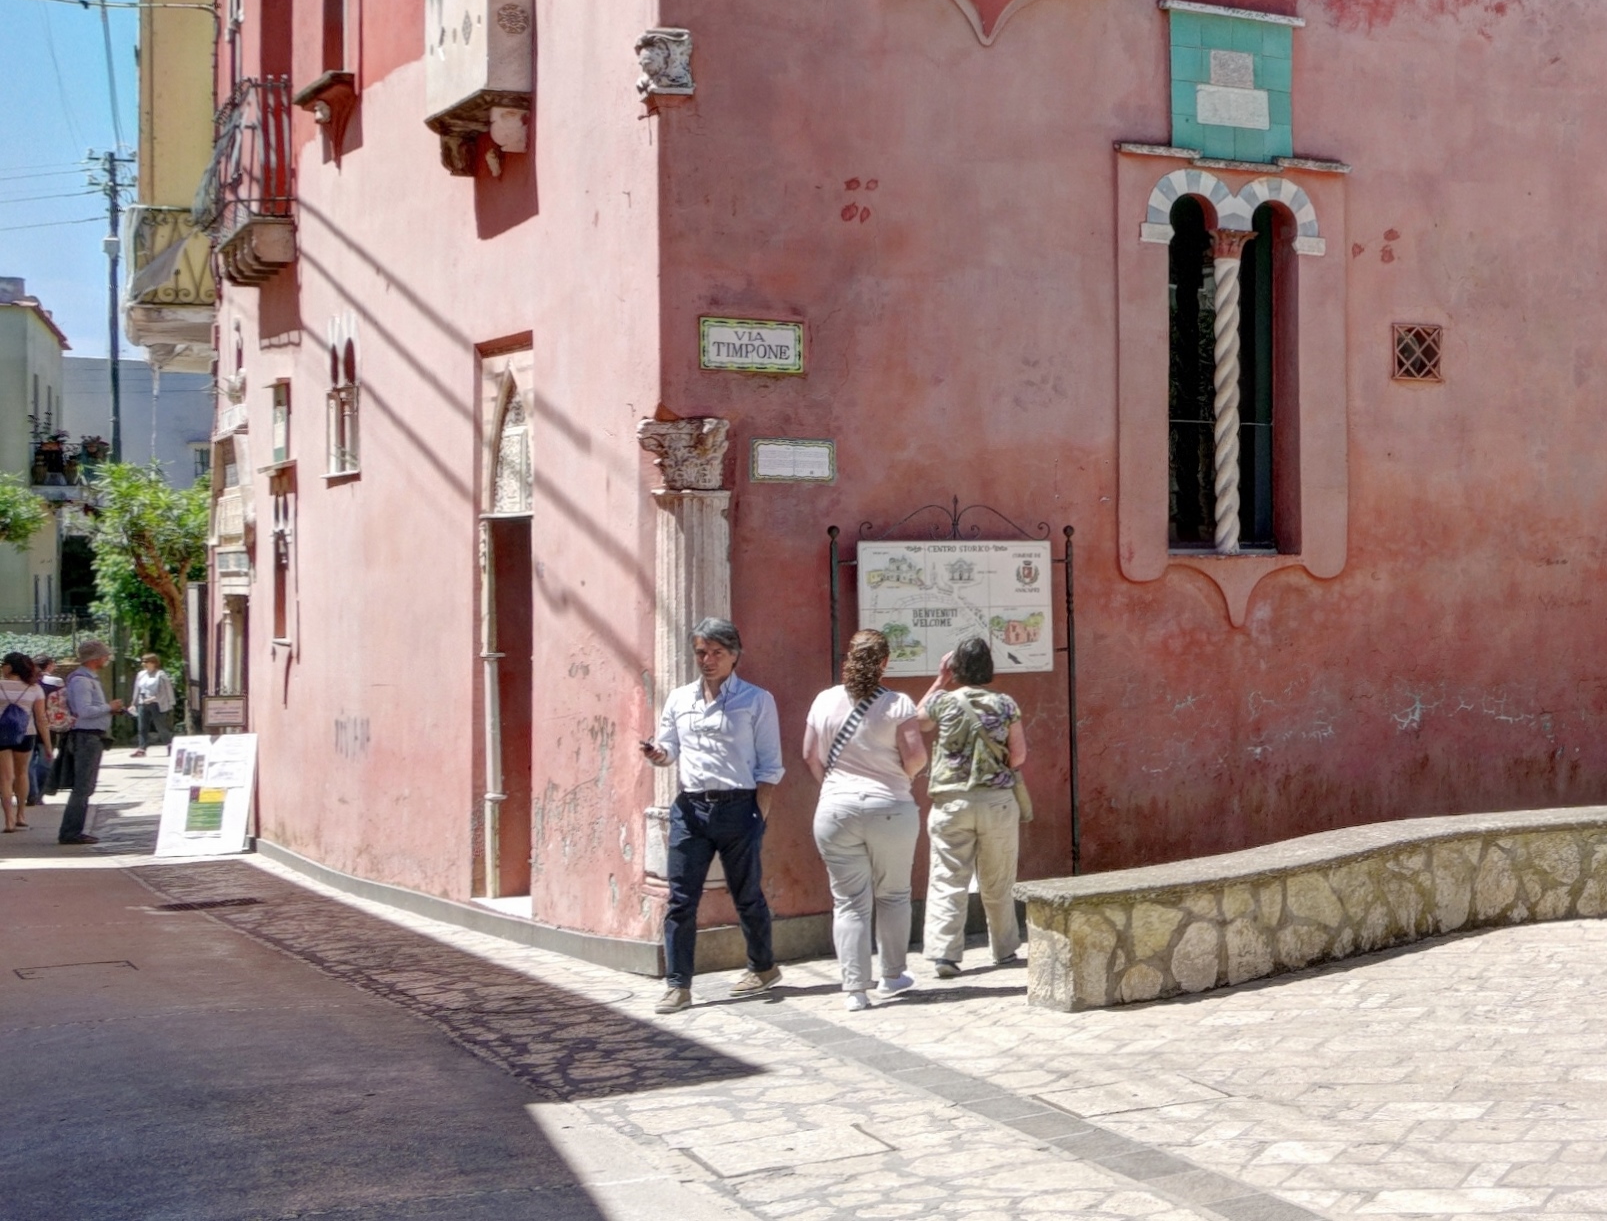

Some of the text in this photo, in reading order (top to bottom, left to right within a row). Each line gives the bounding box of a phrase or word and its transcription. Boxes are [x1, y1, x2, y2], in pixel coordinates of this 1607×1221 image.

[733, 330, 766, 343] VIA
[712, 341, 791, 360] TIMPONE
[927, 544, 990, 553] CENTRO STORICO
[912, 608, 958, 618] BENVENUTI
[912, 619, 953, 628] WELCOME
